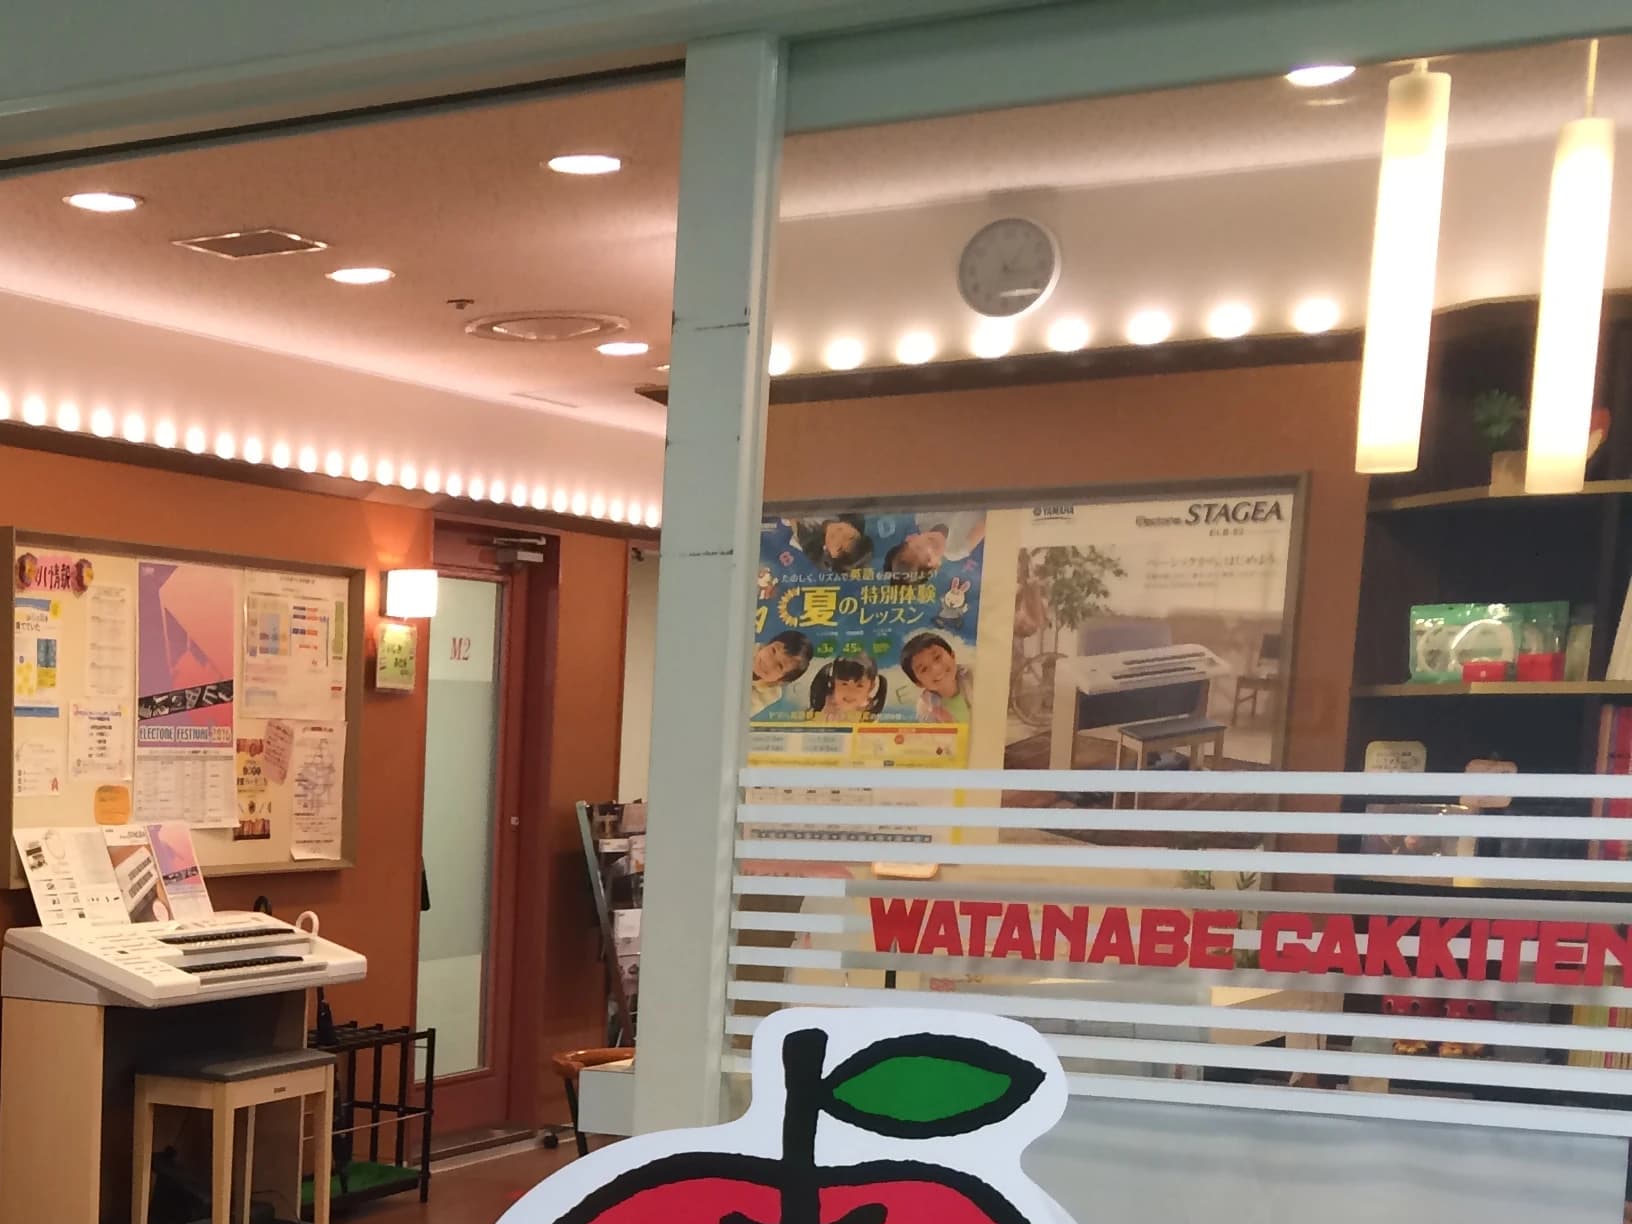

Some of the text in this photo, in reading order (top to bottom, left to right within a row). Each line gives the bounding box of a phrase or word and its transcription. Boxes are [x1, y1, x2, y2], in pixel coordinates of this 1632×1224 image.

[1185, 501, 1285, 526] STAGEA
[859, 584, 937, 606] 特別体験
[859, 606, 924, 625] レッスン
[449, 637, 471, 661] M2
[869, 897, 1632, 986] WATANABE GAKKITEN
